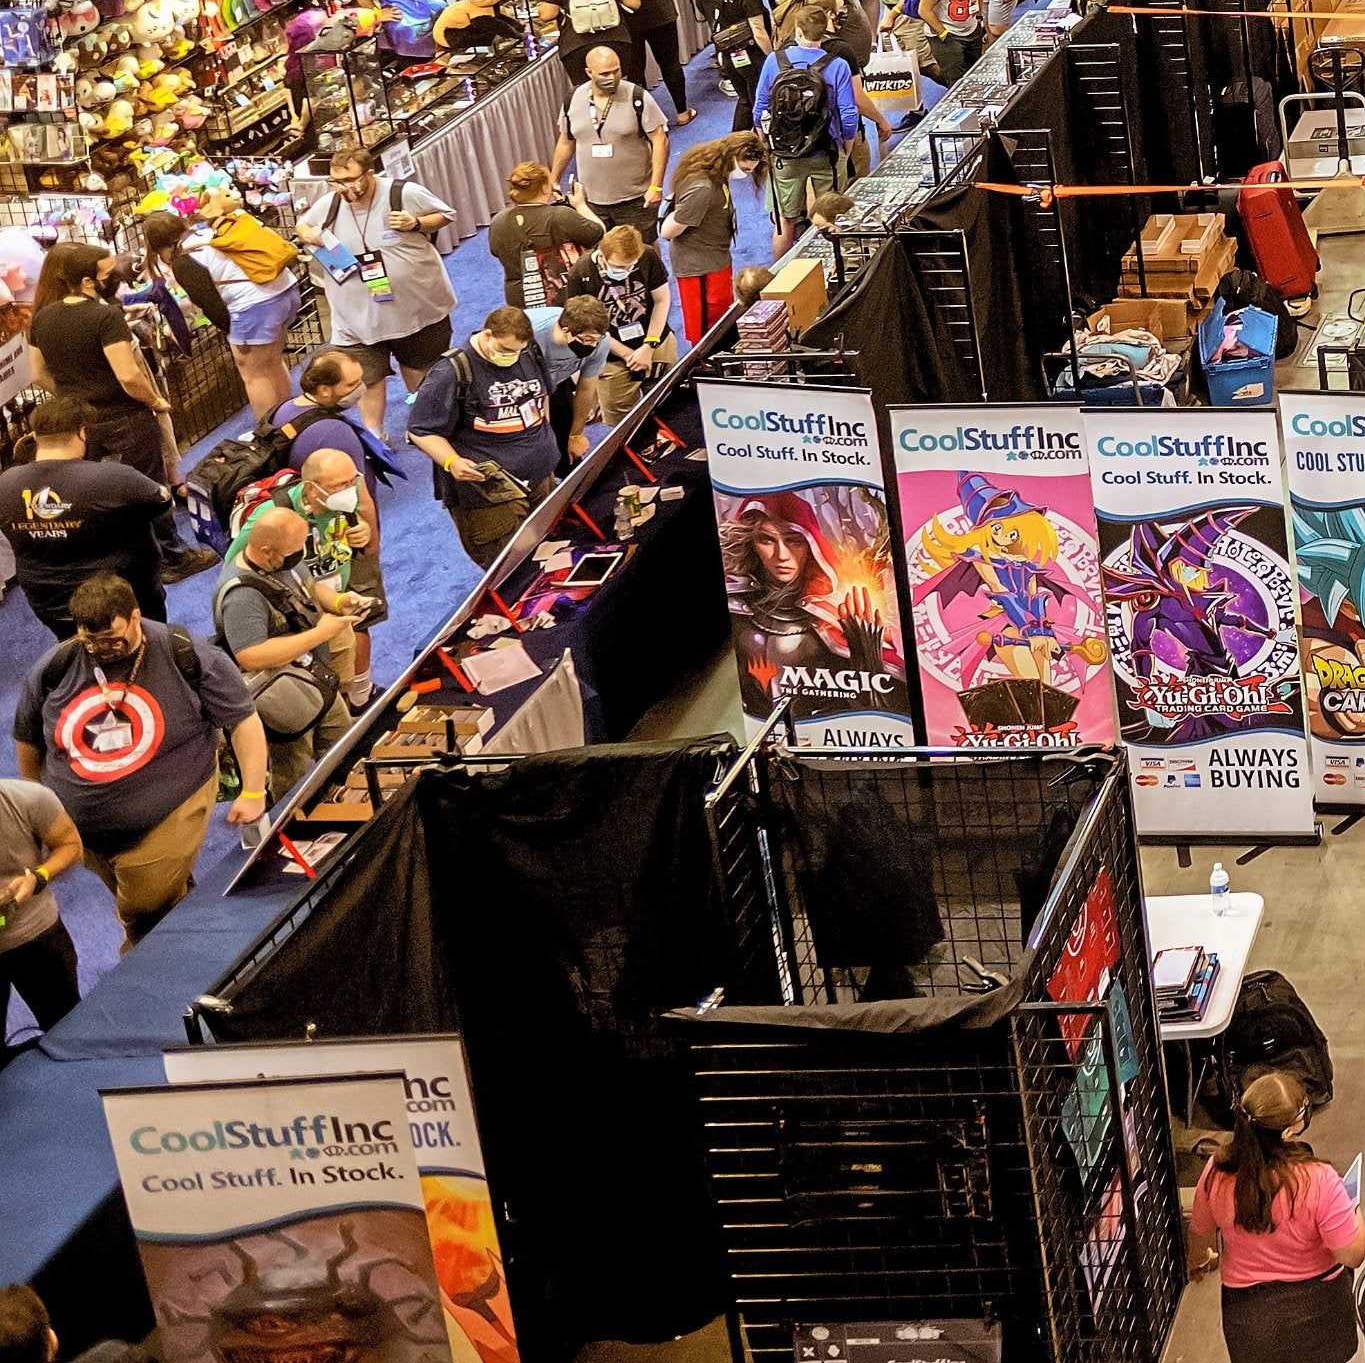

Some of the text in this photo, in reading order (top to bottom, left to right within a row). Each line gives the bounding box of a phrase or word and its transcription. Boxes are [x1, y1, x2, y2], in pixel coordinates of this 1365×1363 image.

[711, 407, 867, 438] CoolStuffInc
[900, 426, 1081, 454] CoolStuffInc
[1097, 433, 1267, 461] CoolStuffInc
[716, 443, 872, 466] Cool Stuff. In Stock.
[1295, 450, 1333, 472] COOL
[1101, 469, 1272, 486] Cool Stuff. In Stock.
[777, 665, 895, 695] MAGIC
[1209, 749, 1298, 770] ALWAYS
[1210, 769, 1301, 790] BUYING
[130, 1115, 394, 1156] CoolStuffInc
[141, 1161, 404, 1194] Cool Stuff. In Stock.
